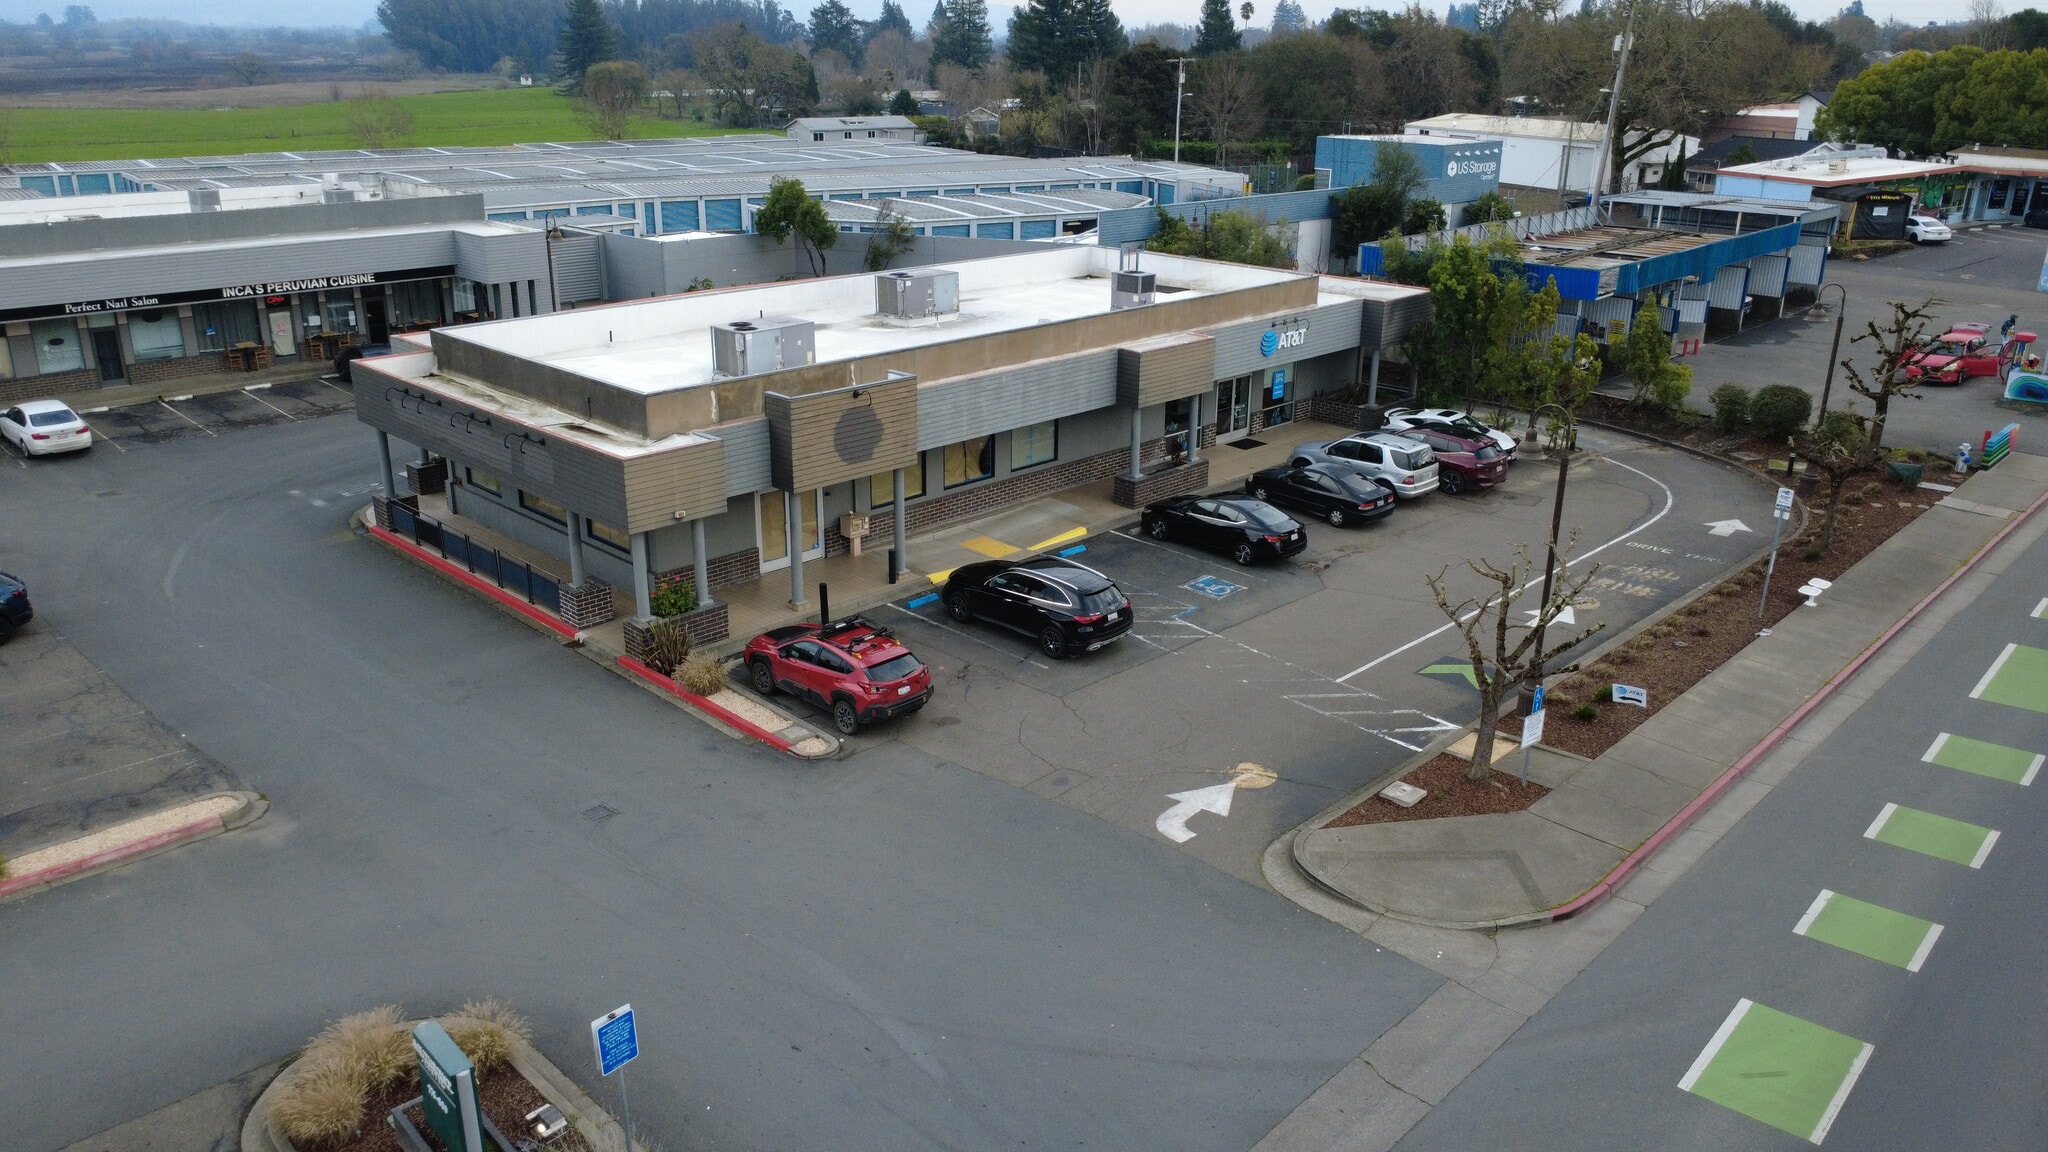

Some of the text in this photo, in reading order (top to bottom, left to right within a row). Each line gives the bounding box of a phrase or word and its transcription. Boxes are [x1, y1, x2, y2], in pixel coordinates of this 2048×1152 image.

[1457, 161, 1497, 175] US Storage
[222, 273, 376, 298] INCA'S PERUVIAN CUISINE
[65, 296, 159, 313] Perfect Nail Salon
[1278, 328, 1306, 350] AT&T
[1625, 541, 1675, 554] DRIVE
